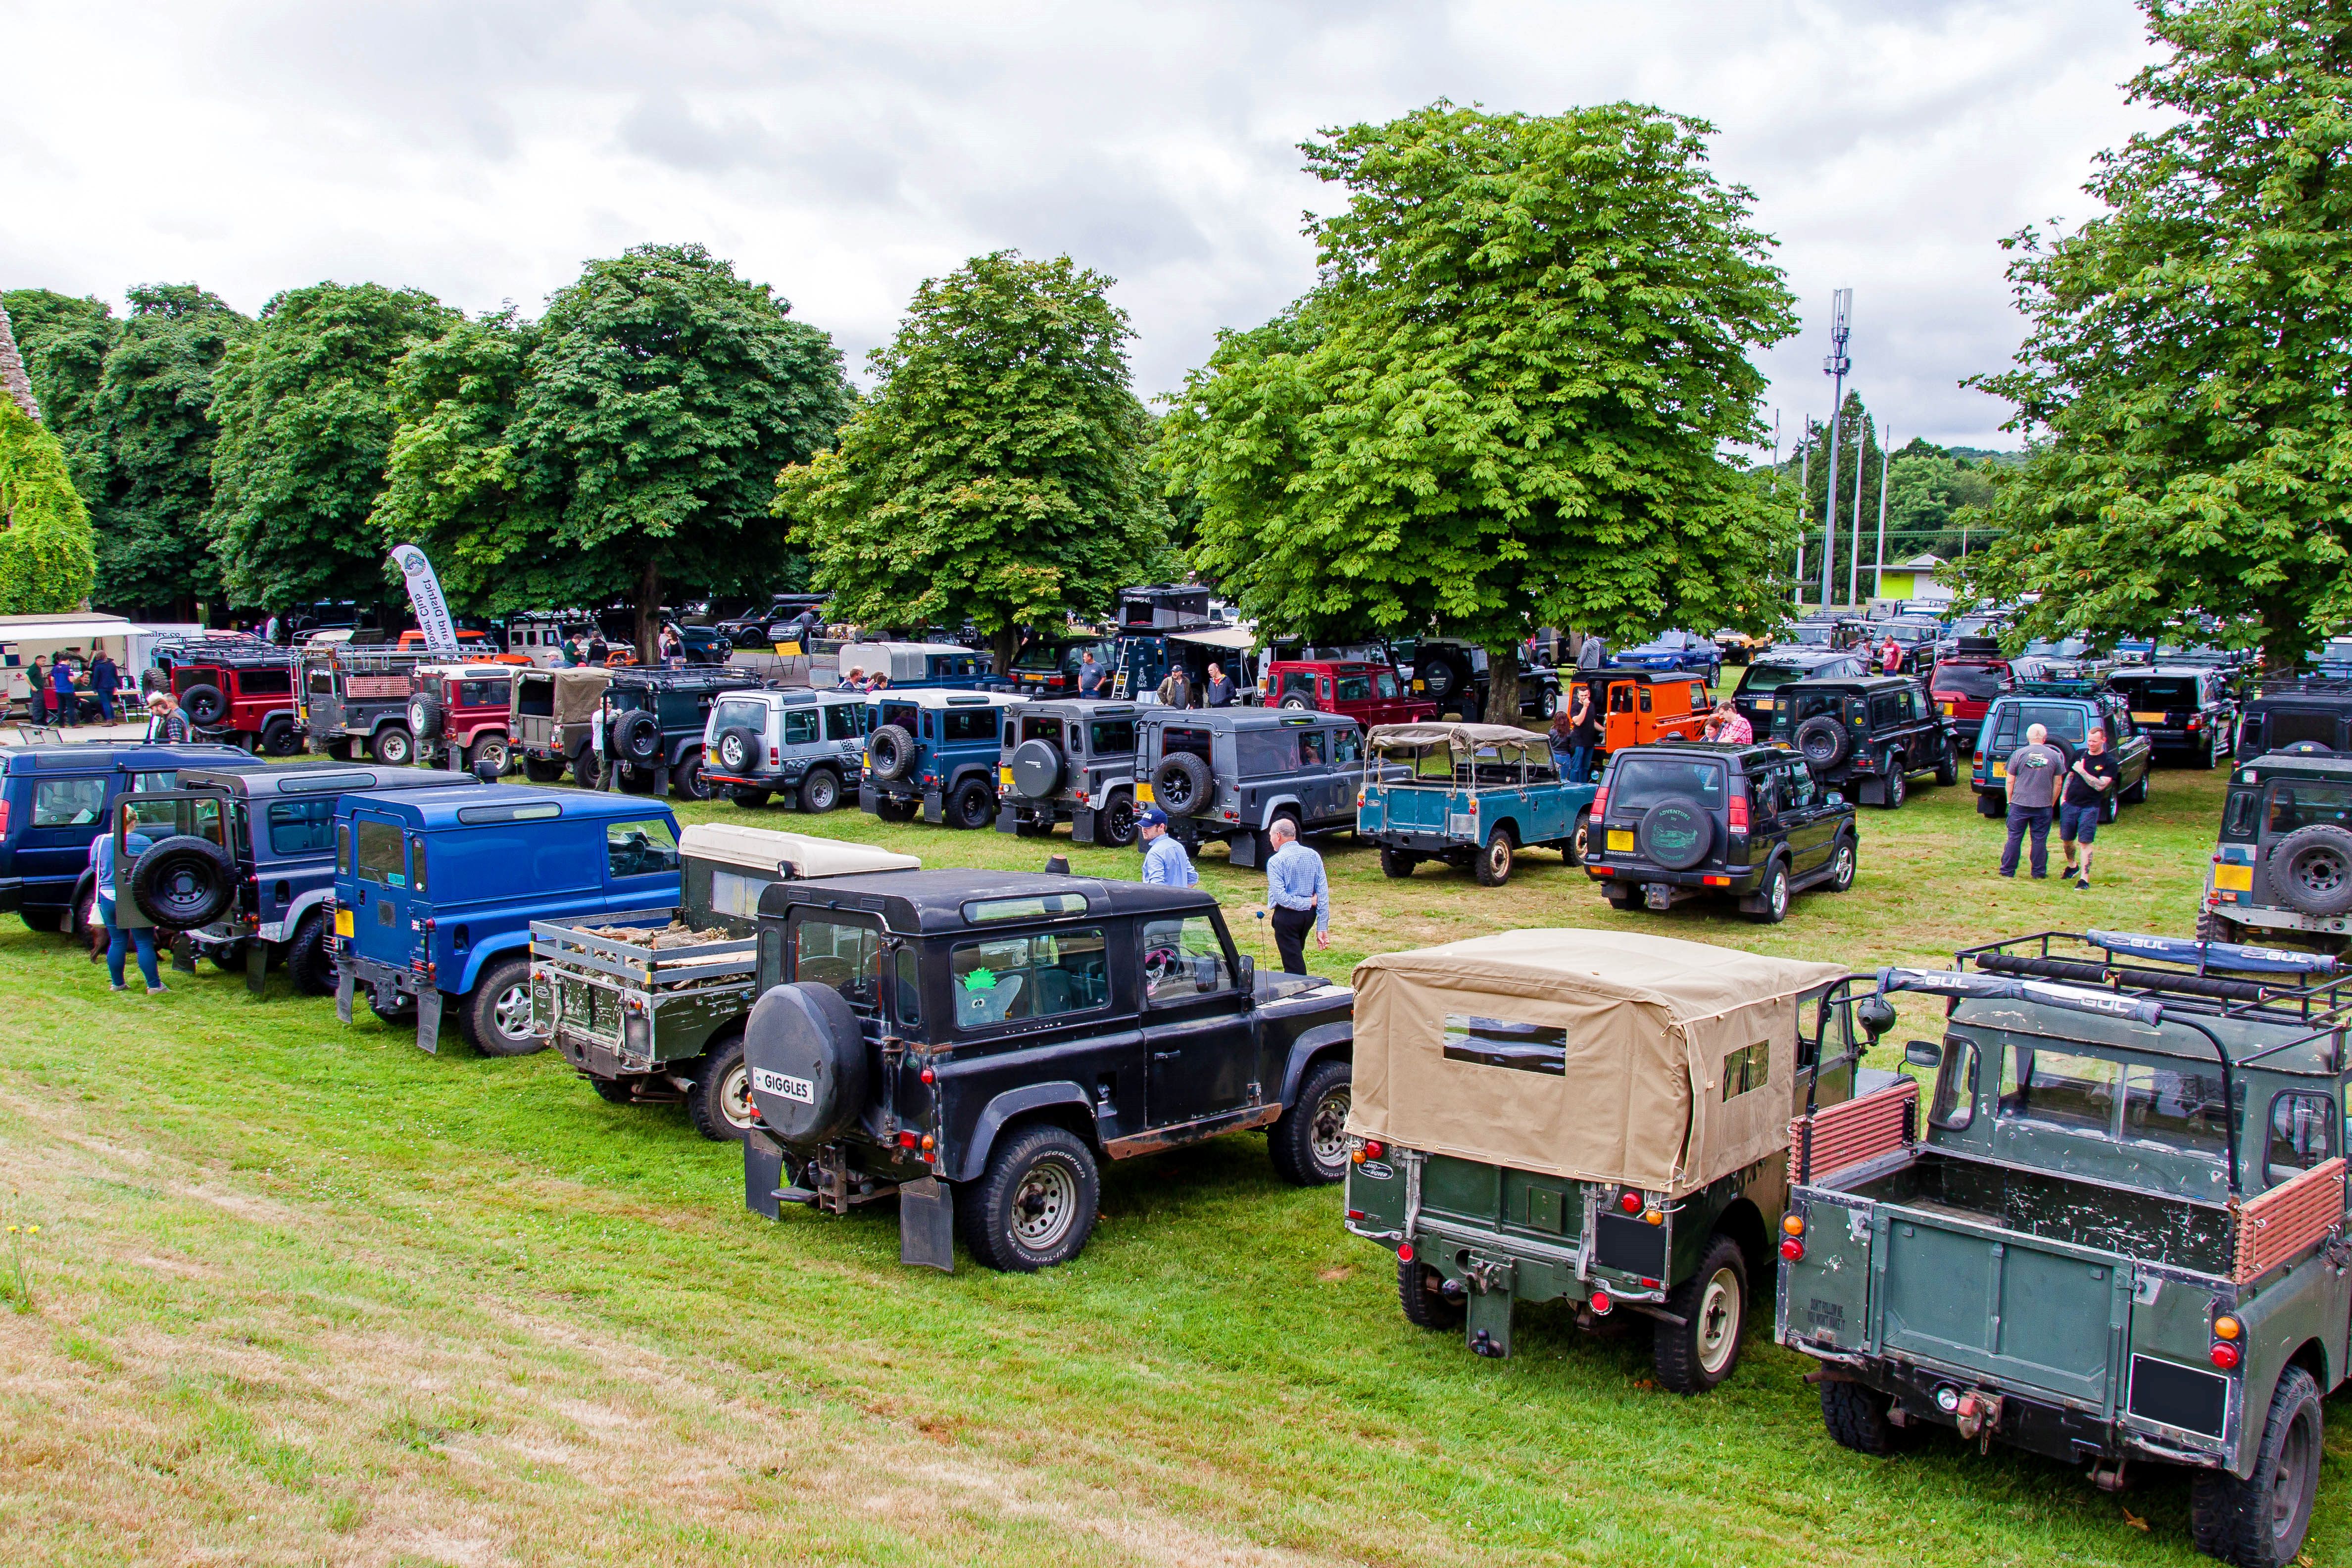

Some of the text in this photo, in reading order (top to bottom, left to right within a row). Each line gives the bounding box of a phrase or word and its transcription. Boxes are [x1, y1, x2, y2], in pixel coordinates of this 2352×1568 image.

[1659, 809, 1691, 821] ADVENTURE
[2130, 938, 2169, 950] GUL
[2265, 950, 2309, 964] GUL
[1925, 976, 1970, 989] GUL
[2079, 996, 2130, 1013] GUL
[765, 1075, 808, 1097] GIGGLES
[1007, 1230, 1068, 1262] All-Terrain T/A
